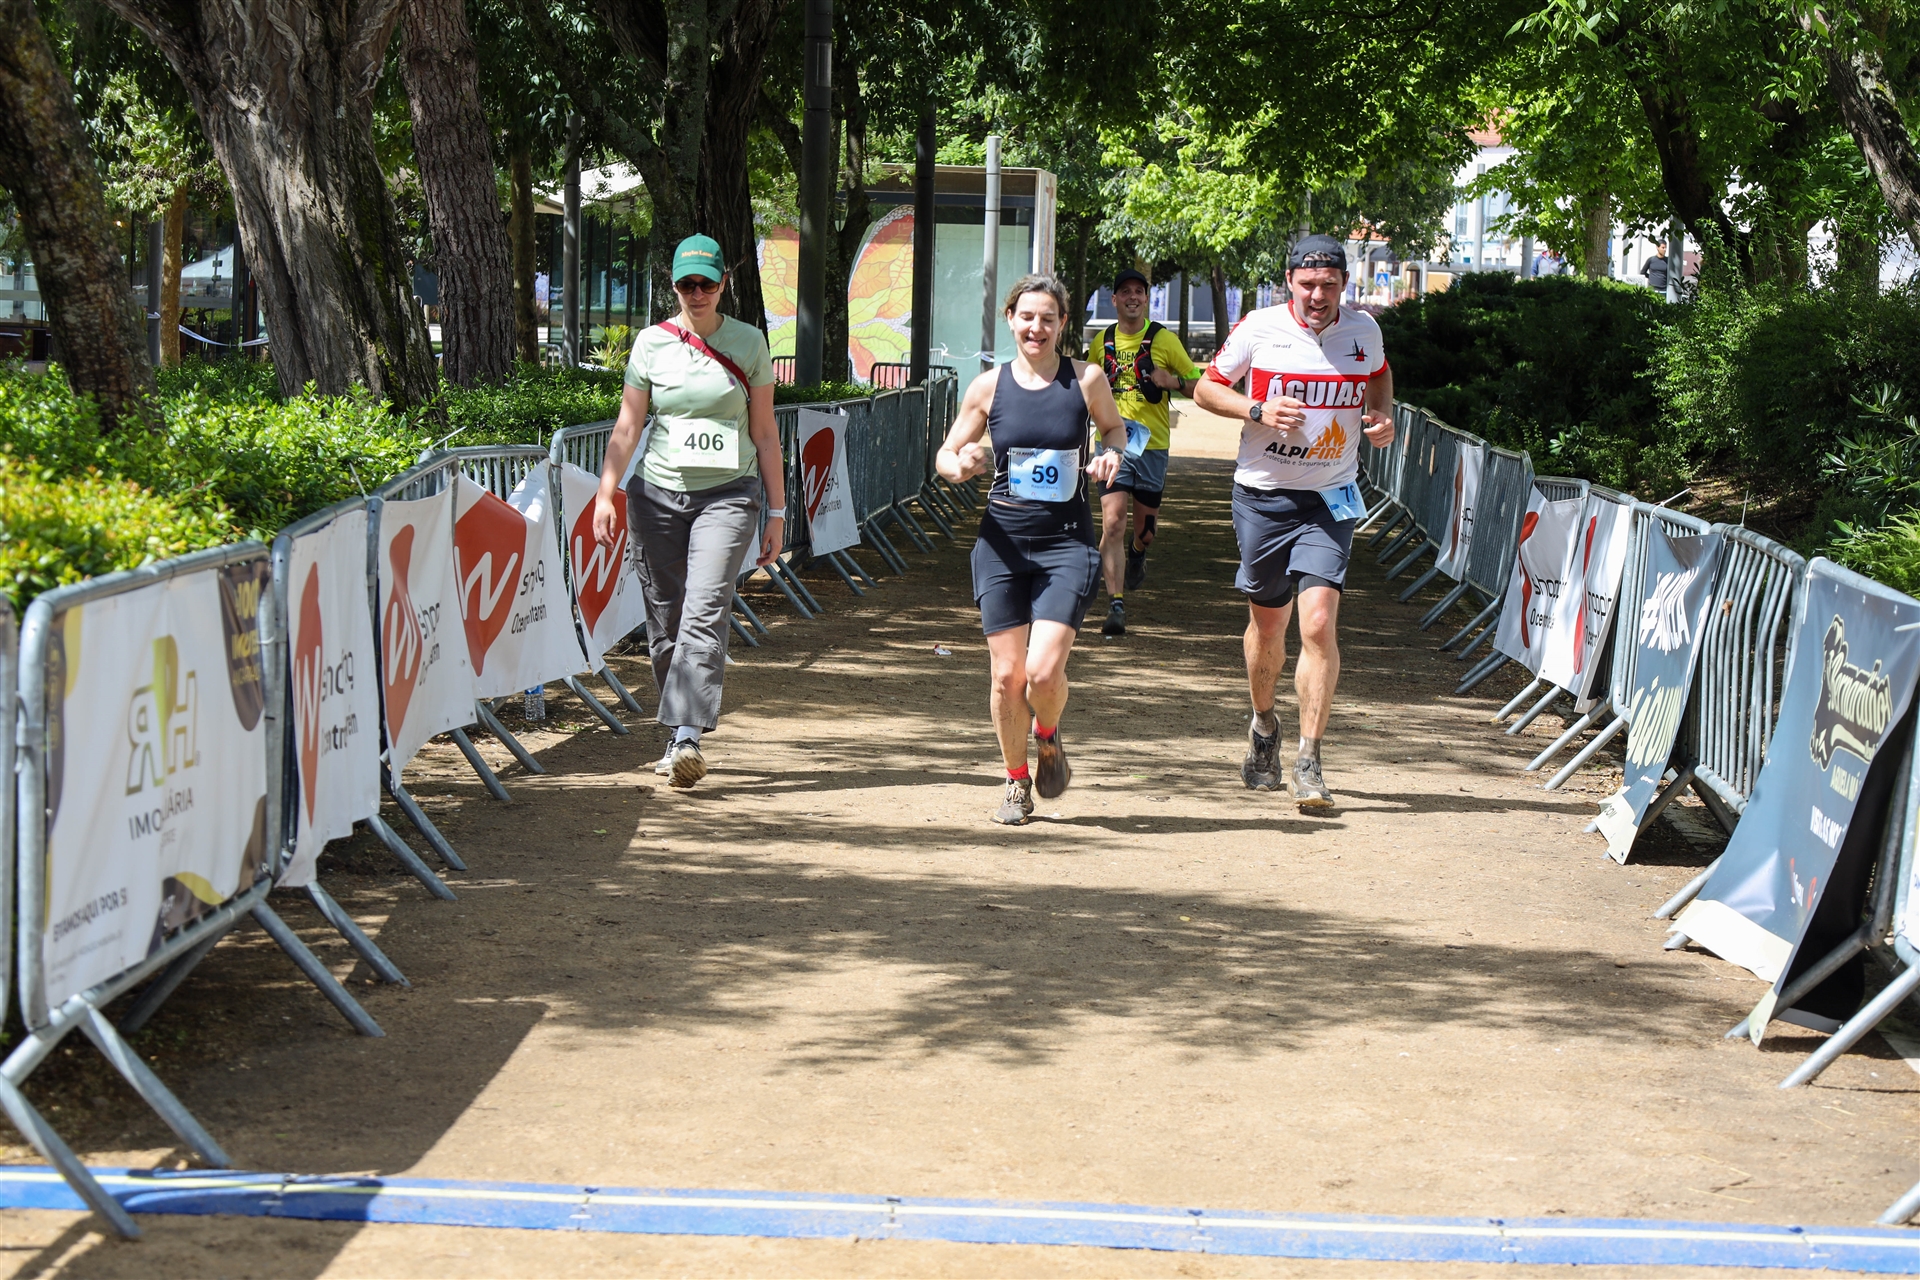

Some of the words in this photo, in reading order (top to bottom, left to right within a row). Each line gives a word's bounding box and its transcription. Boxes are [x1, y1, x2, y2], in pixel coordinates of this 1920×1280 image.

[1265, 374, 1367, 407] ÁGUIAS
[683, 432, 724, 452] 406
[1264, 441, 1345, 460] ALPIFIRE
[1031, 464, 1059, 485] 59
